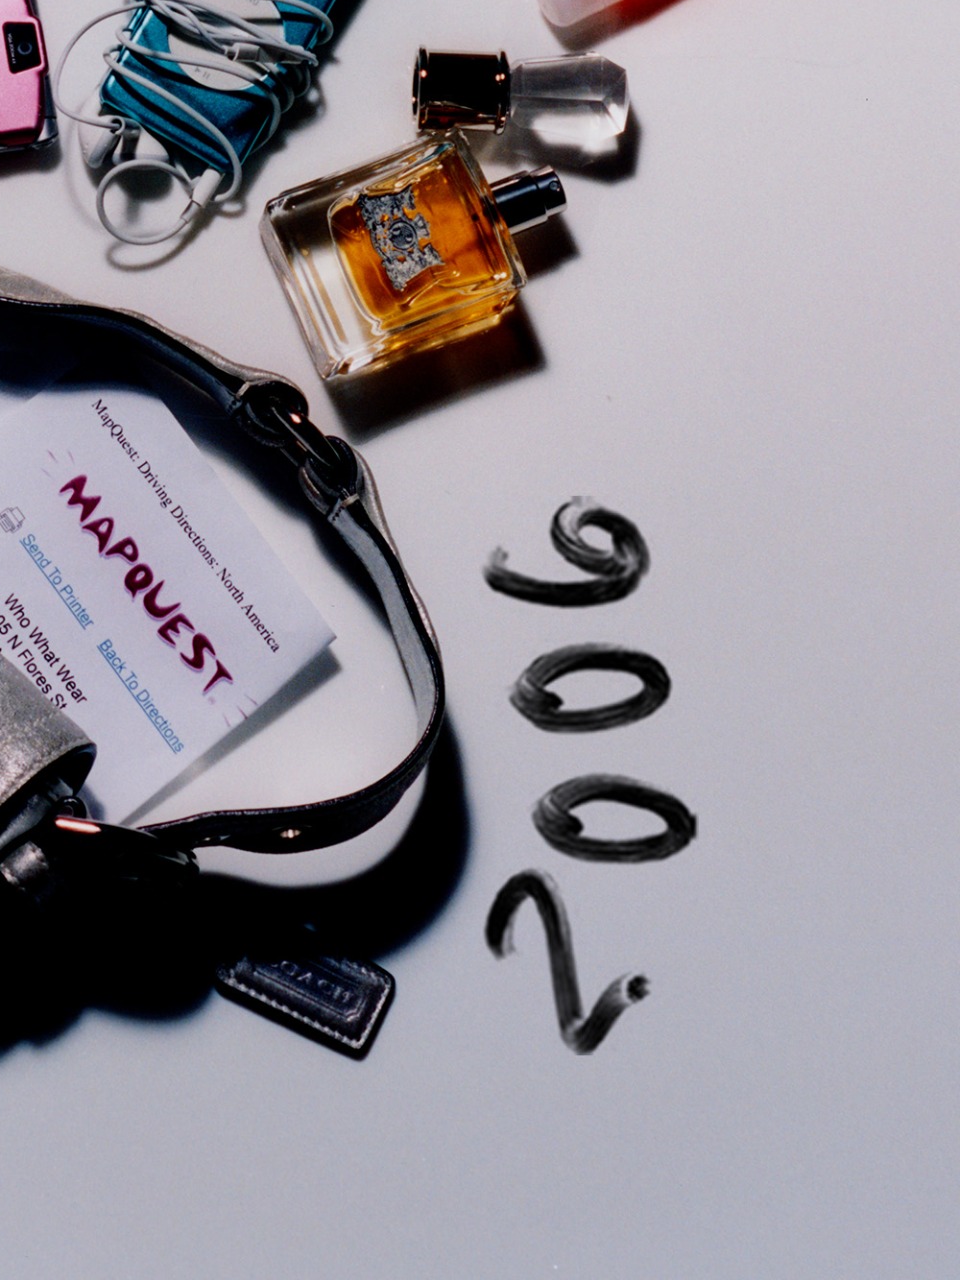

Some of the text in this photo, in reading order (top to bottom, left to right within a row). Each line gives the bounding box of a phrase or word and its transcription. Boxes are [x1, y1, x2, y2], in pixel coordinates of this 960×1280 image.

[58, 472, 235, 697] MAPQUEST
[92, 398, 280, 653] MapQuest: Driving Directions: North America
[4, 593, 88, 705] Who What Wear
[6, 633, 24, 651] N
[17, 647, 53, 695] Flores
[20, 533, 185, 754] Send To Printer Back To Directions
[269, 960, 354, 1004] OACH
